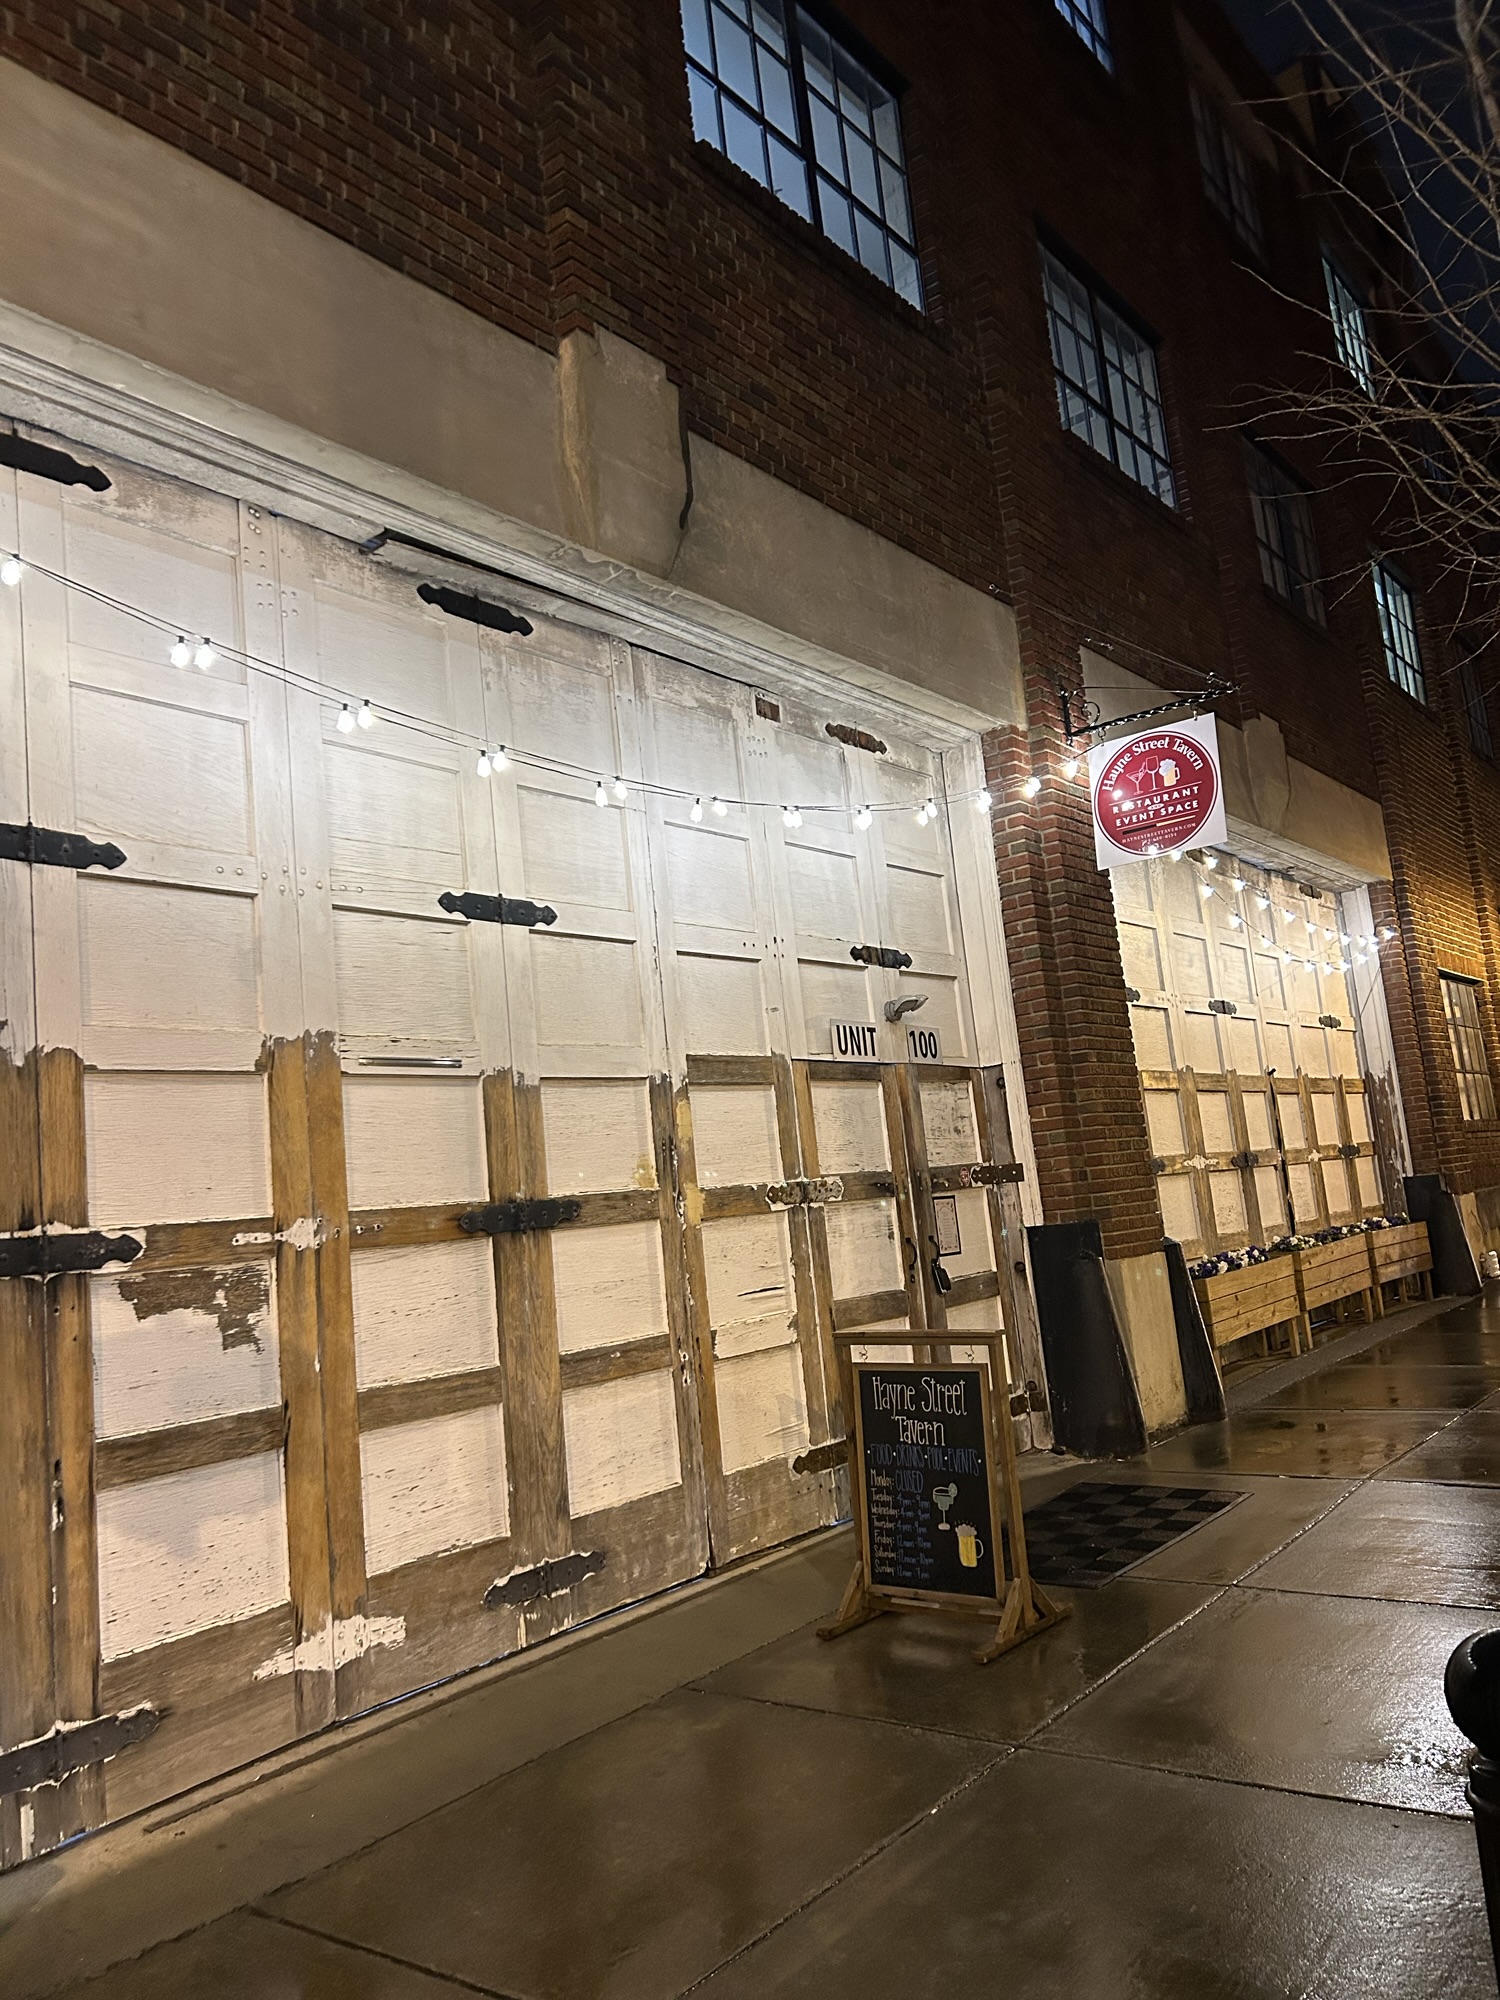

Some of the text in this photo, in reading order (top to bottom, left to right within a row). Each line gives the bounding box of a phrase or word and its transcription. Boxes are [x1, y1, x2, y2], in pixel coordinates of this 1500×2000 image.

[1102, 736, 1204, 792] Hayne Street Tavern
[1112, 786, 1200, 814] RSTAURANT
[1116, 800, 1199, 827] EVENT SPACE
[836, 1025, 938, 1059] UNIT 100
[872, 1376, 968, 1419] Hayne Street
[895, 1415, 946, 1447] Tavern
[870, 1443, 980, 1477] FOOD DRINKS POOL EVENTS
[895, 1469, 923, 1494] CLOSED
